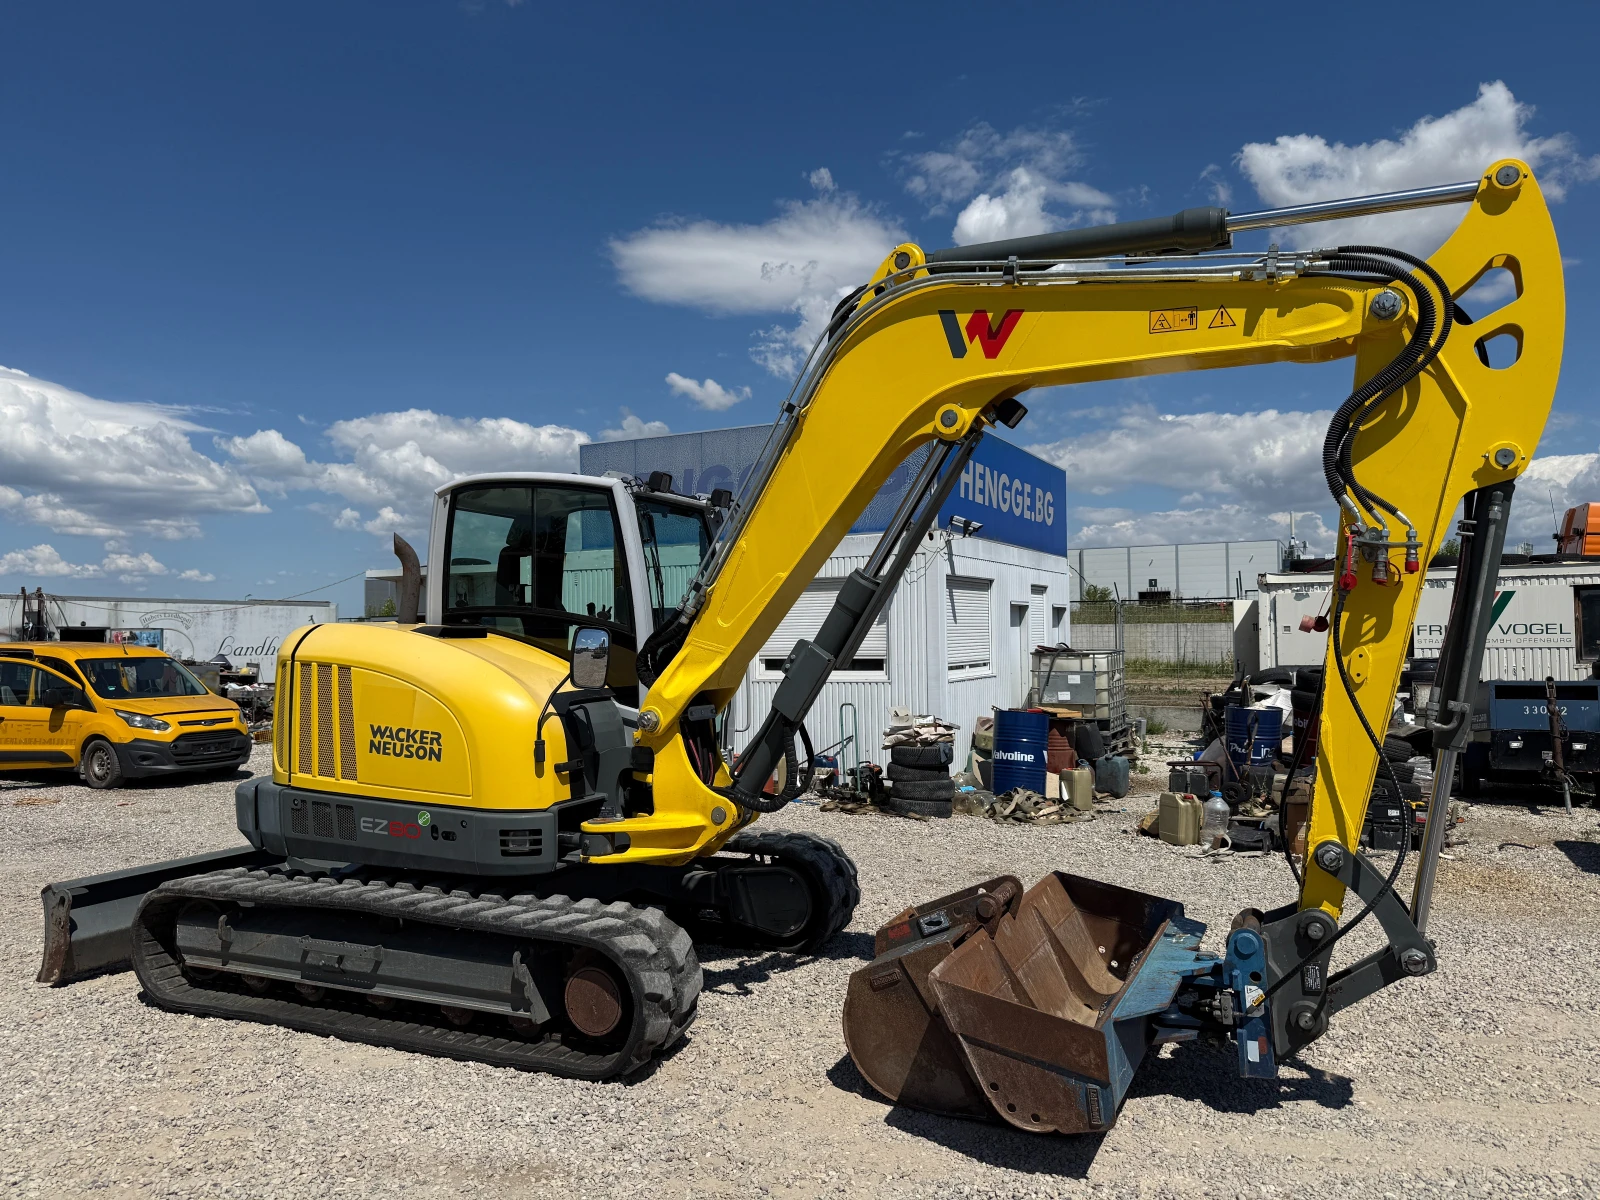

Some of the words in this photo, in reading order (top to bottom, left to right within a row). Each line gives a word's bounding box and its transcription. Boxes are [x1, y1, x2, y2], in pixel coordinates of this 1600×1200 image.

[1498, 623, 1571, 634] VOGEL
[1523, 705, 1567, 715] 3302
[370, 724, 442, 747] WACKER
[369, 739, 442, 762] NEUSON
